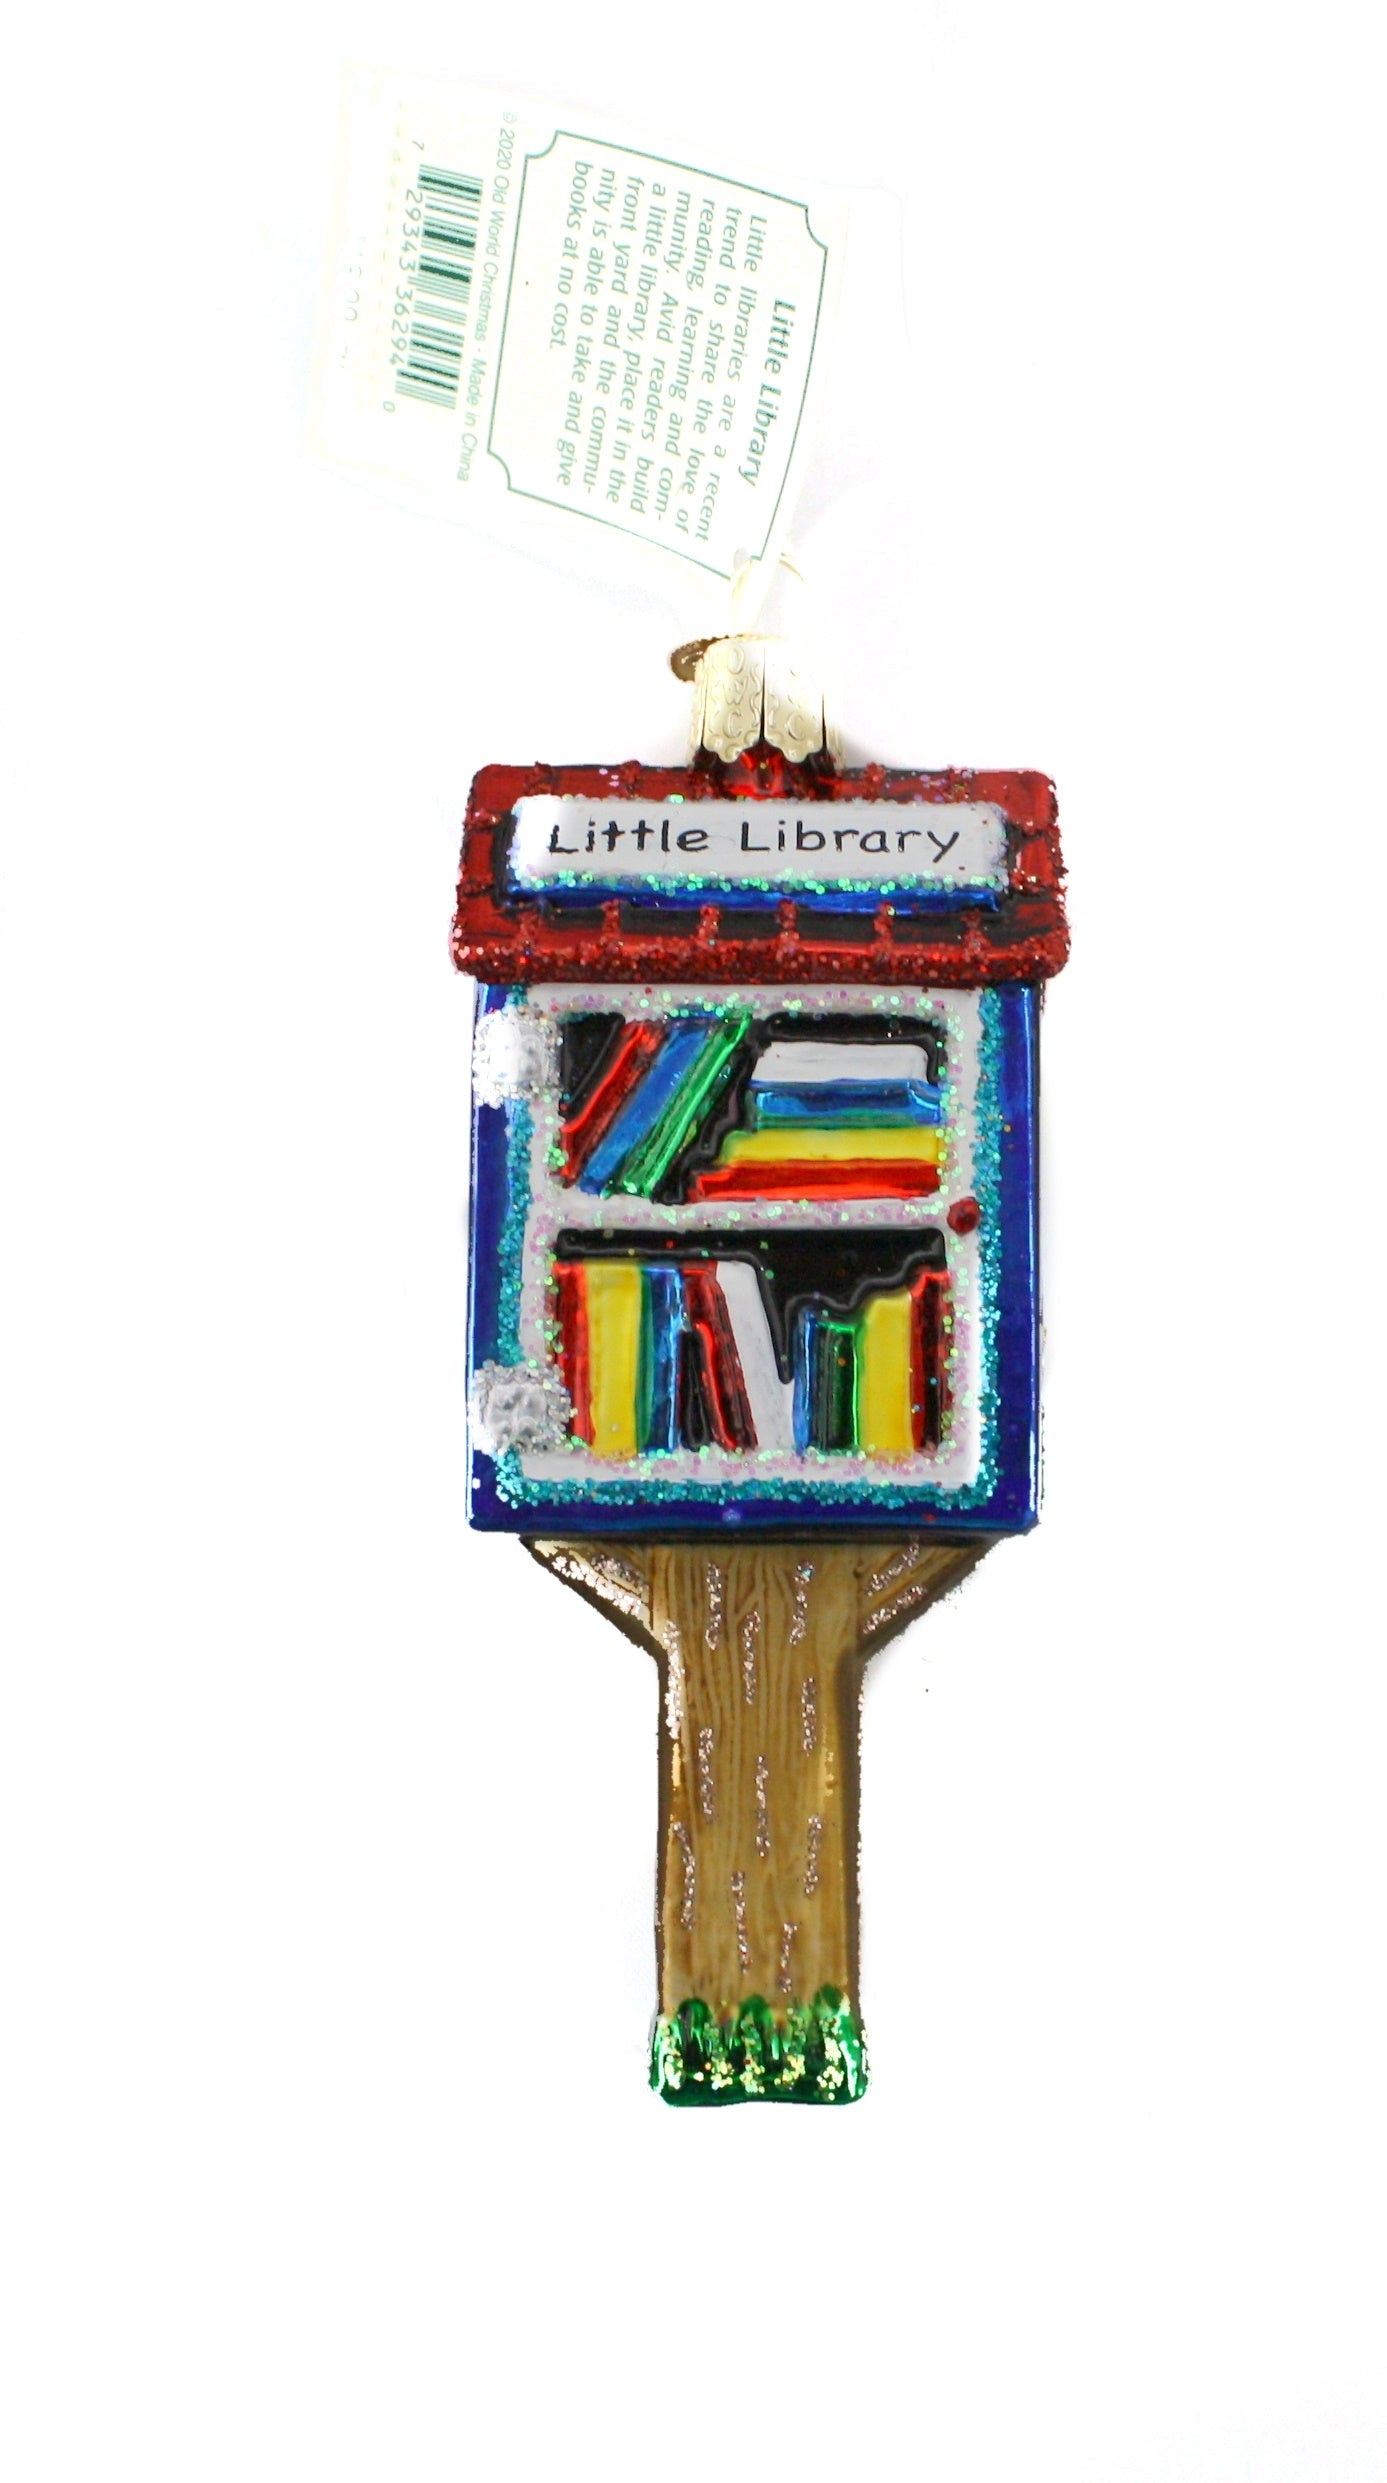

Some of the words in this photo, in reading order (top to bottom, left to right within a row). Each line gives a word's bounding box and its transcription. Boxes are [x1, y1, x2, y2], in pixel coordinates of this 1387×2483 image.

[411, 138, 425, 152] 7
[494, 127, 516, 171] 2020
[490, 174, 510, 206] Old
[565, 160, 594, 230] books
[591, 168, 616, 213] nity
[619, 176, 645, 232] front
[651, 183, 666, 197] a
[398, 187, 424, 274] 29343
[484, 210, 505, 258] World
[561, 237, 579, 260] at
[592, 220, 611, 239] is
[641, 205, 667, 257] little
[662, 191, 691, 273] munity.
[685, 198, 716, 292] reading,
[718, 207, 743, 270] trend
[742, 214, 768, 273] Little
[556, 266, 574, 295] no
[583, 246, 606, 296] able
[610, 242, 631, 296] yard
[473, 261, 500, 342] Christmas
[579, 304, 598, 326] to
[626, 264, 658, 342] library,
[655, 291, 679, 344] Avid
[712, 283, 732, 306] to
[388, 284, 414, 367] 36294
[549, 302, 569, 351] cost.
[602, 305, 622, 349] and
[726, 286, 758, 380] libraries
[763, 299, 796, 375] Little
[571, 335, 593, 384] take
[596, 359, 616, 395] the
[668, 306, 704, 402] learning
[700, 321, 725, 384] share
[465, 358, 488, 407] Made
[619, 350, 643, 411] place
[640, 358, 666, 442] readers
[382, 400, 397, 414] 0
[463, 411, 480, 428] in
[564, 391, 583, 434] and
[615, 418, 633, 434] it
[692, 399, 713, 434] the
[717, 394, 736, 432] are
[455, 432, 479, 483] China
[582, 406, 606, 493] commu-
[612, 441, 631, 461] in
[663, 412, 683, 457] and
[712, 444, 726, 459] a
[737, 383, 782, 487] Library
[556, 438, 578, 487] give
[606, 469, 626, 503] the
[629, 456, 654, 514] build
[680, 448, 706, 495] love
[654, 467, 673, 521] com-
[694, 472, 720, 541] recent
[674, 509, 689, 534] of
[548, 819, 709, 855] Little
[740, 819, 960, 863] Library
